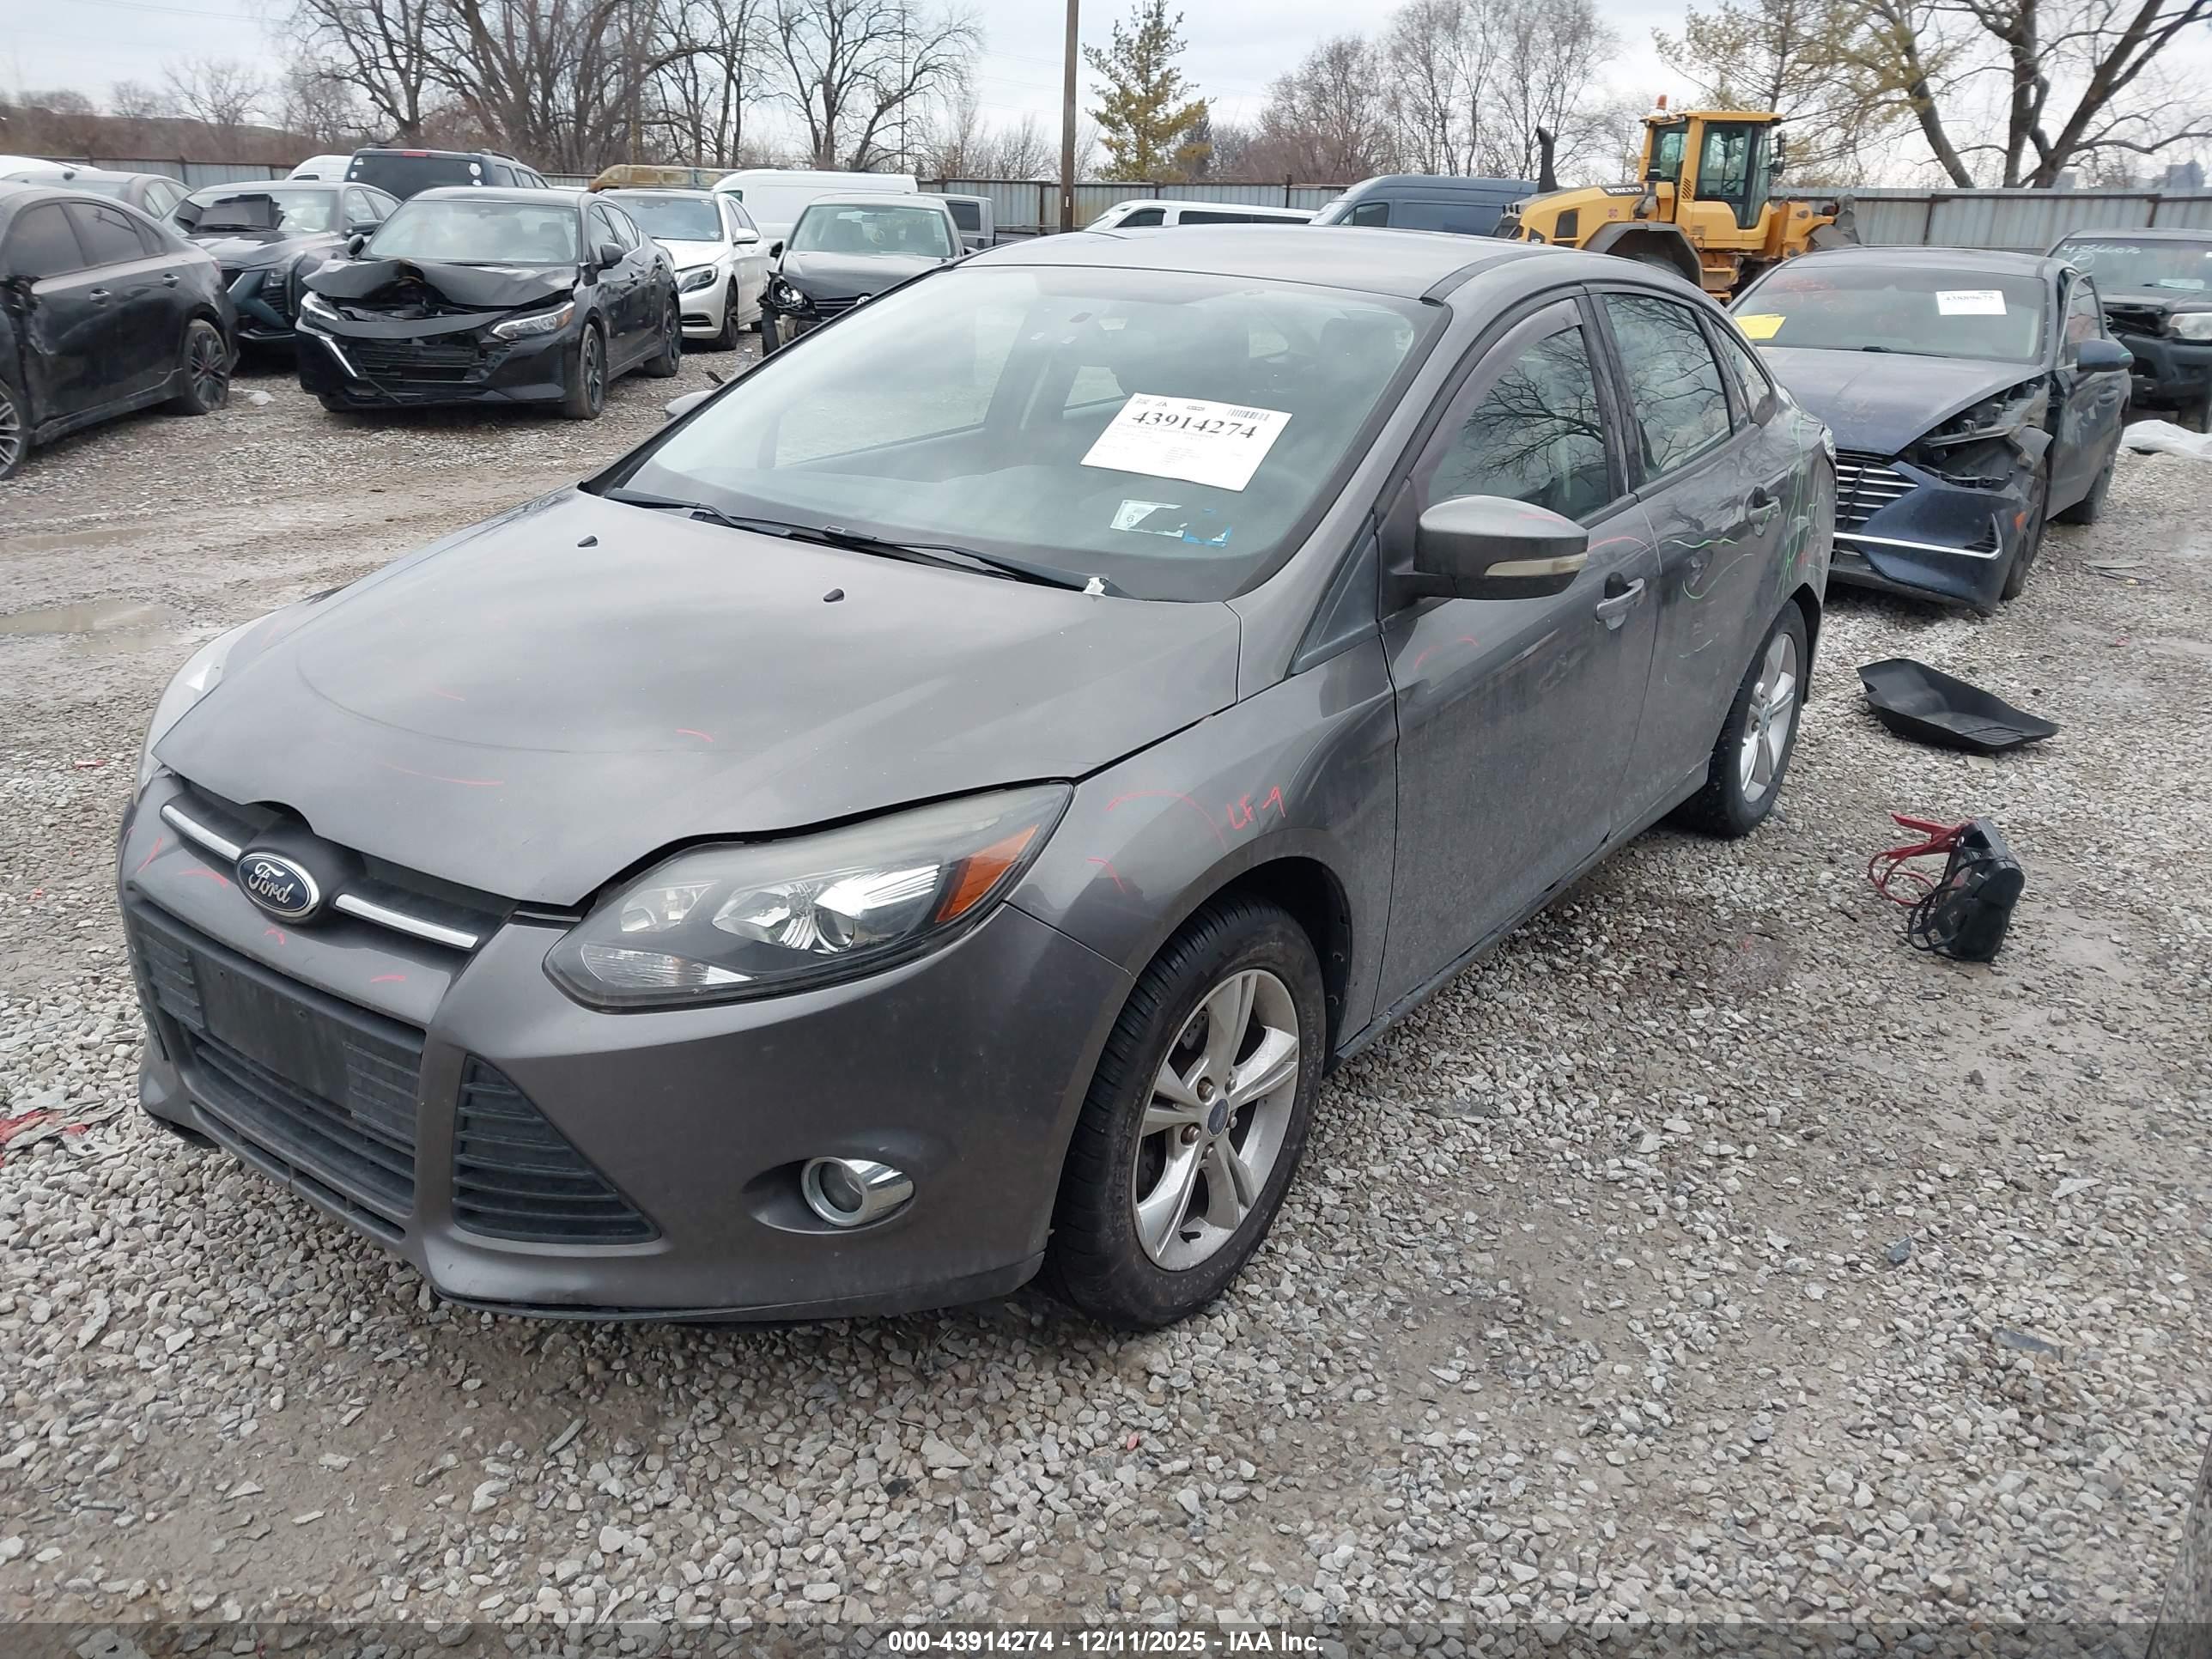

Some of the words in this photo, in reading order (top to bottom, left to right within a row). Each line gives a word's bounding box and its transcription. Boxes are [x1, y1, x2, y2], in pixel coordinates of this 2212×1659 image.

[1606, 185, 1643, 194] VOLVO
[1132, 410, 1258, 439] 43914274
[248, 861, 295, 904] Ford
